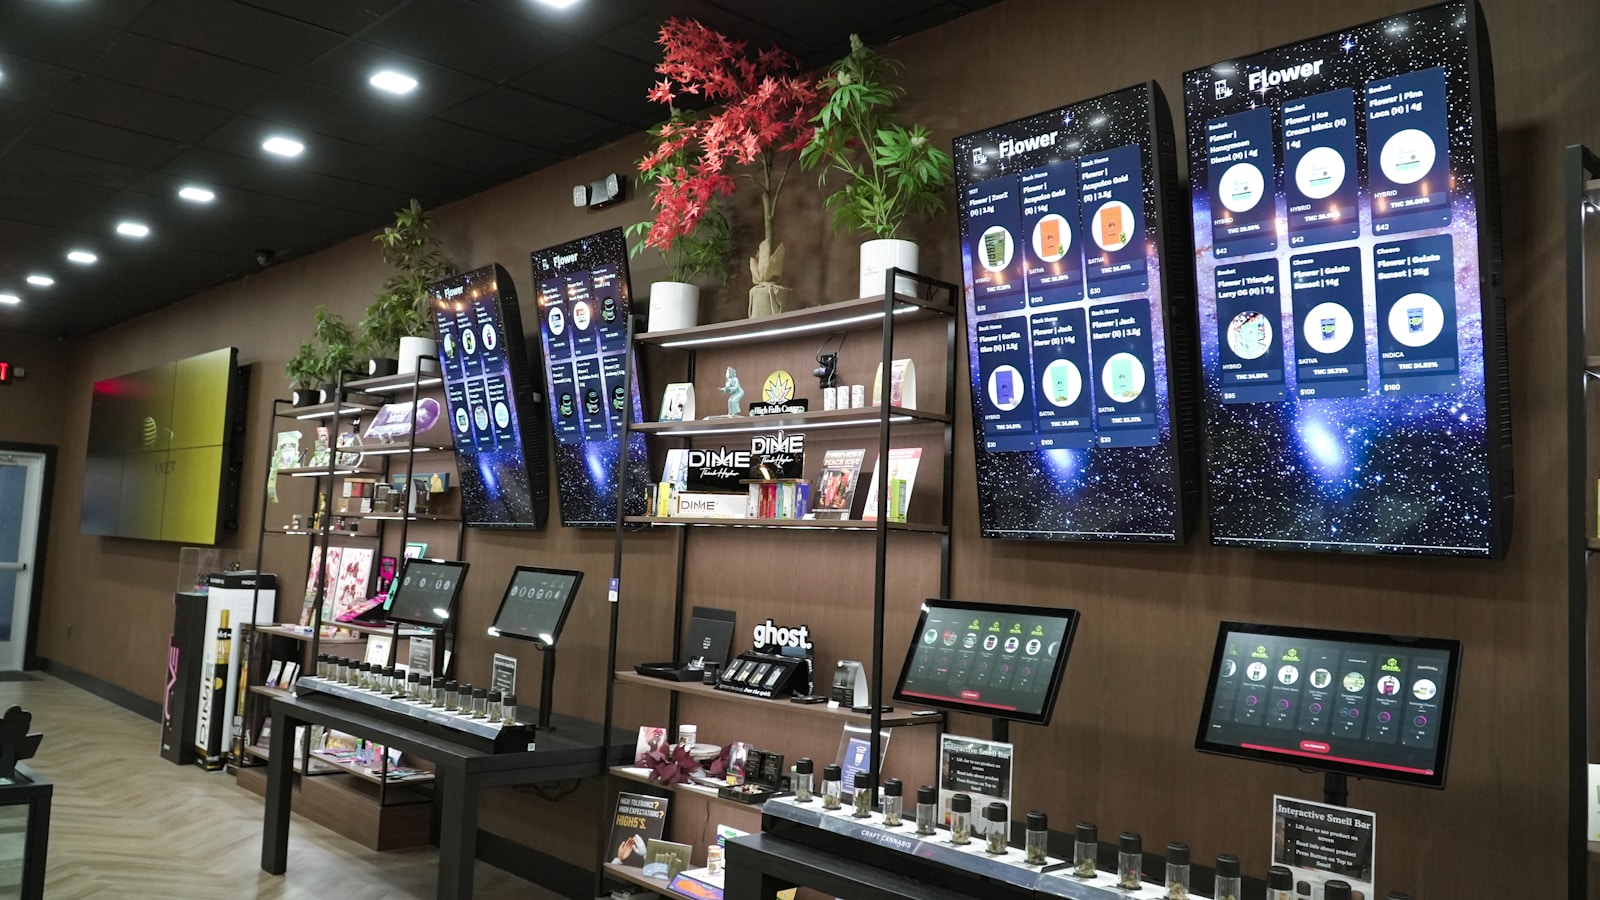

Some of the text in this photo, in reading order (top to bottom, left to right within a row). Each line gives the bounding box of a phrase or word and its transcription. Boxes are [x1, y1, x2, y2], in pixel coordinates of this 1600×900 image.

[1249, 60, 1323, 91] Flower
[1369, 96, 1398, 108] Flower
[1370, 110, 1390, 120] Loca
[1410, 103, 1422, 112] 4g
[1285, 110, 1328, 126] Flower Ice
[1210, 131, 1233, 142] Flower
[1286, 127, 1310, 137] Cream
[999, 131, 1058, 158] Flower
[1210, 140, 1250, 153] Honeymoon
[1291, 140, 1301, 149] 4g
[1211, 153, 1231, 164] Diesel
[1248, 149, 1258, 158] 4g
[1082, 170, 1104, 180] Flower
[1022, 182, 1044, 194] Flower
[1082, 174, 1128, 192] Acapulco Gold
[1052, 188, 1066, 198] Gold
[1374, 190, 1397, 199] HYBRID
[970, 197, 988, 206] Flower
[1390, 201, 1404, 209] THC
[1290, 204, 1311, 213] HYBRID
[1305, 214, 1317, 222] THC
[1376, 224, 1389, 232] $42
[1292, 237, 1304, 245] $42
[553, 253, 578, 267] Flower
[1378, 254, 1440, 268] Flower Gelato
[1294, 265, 1350, 278] Flower Gelato
[1378, 267, 1429, 280] Sunset 28g
[1218, 274, 1274, 288] Flower Triangle
[1294, 280, 1320, 290] Sunset
[444, 286, 464, 298] Flower
[1218, 290, 1236, 299] Larry
[1092, 316, 1136, 329] Flower Jack
[1033, 324, 1072, 337] Flower Jack
[1093, 332, 1111, 341] Herer
[979, 332, 1020, 343] Flower Gorilla
[754, 405, 782, 415] High Falls
[752, 430, 804, 454] DIME
[688, 445, 750, 468] DIME
[681, 500, 715, 510] DIME
[754, 620, 812, 650] ghost.
[944, 742, 1010, 760] Interactive Smell Bar
[616, 814, 646, 830] HIGH5'S.
[1278, 804, 1372, 830] Interactive Smell Bar
[861, 830, 912, 849] CRAFT CANNABIS
[1318, 836, 1334, 844] screen
[1330, 830, 1350, 840] product
[1296, 840, 1357, 858] Read info about product
[1296, 849, 1309, 858] Press
[1310, 852, 1328, 862] Button
[1316, 860, 1332, 870] Smell
